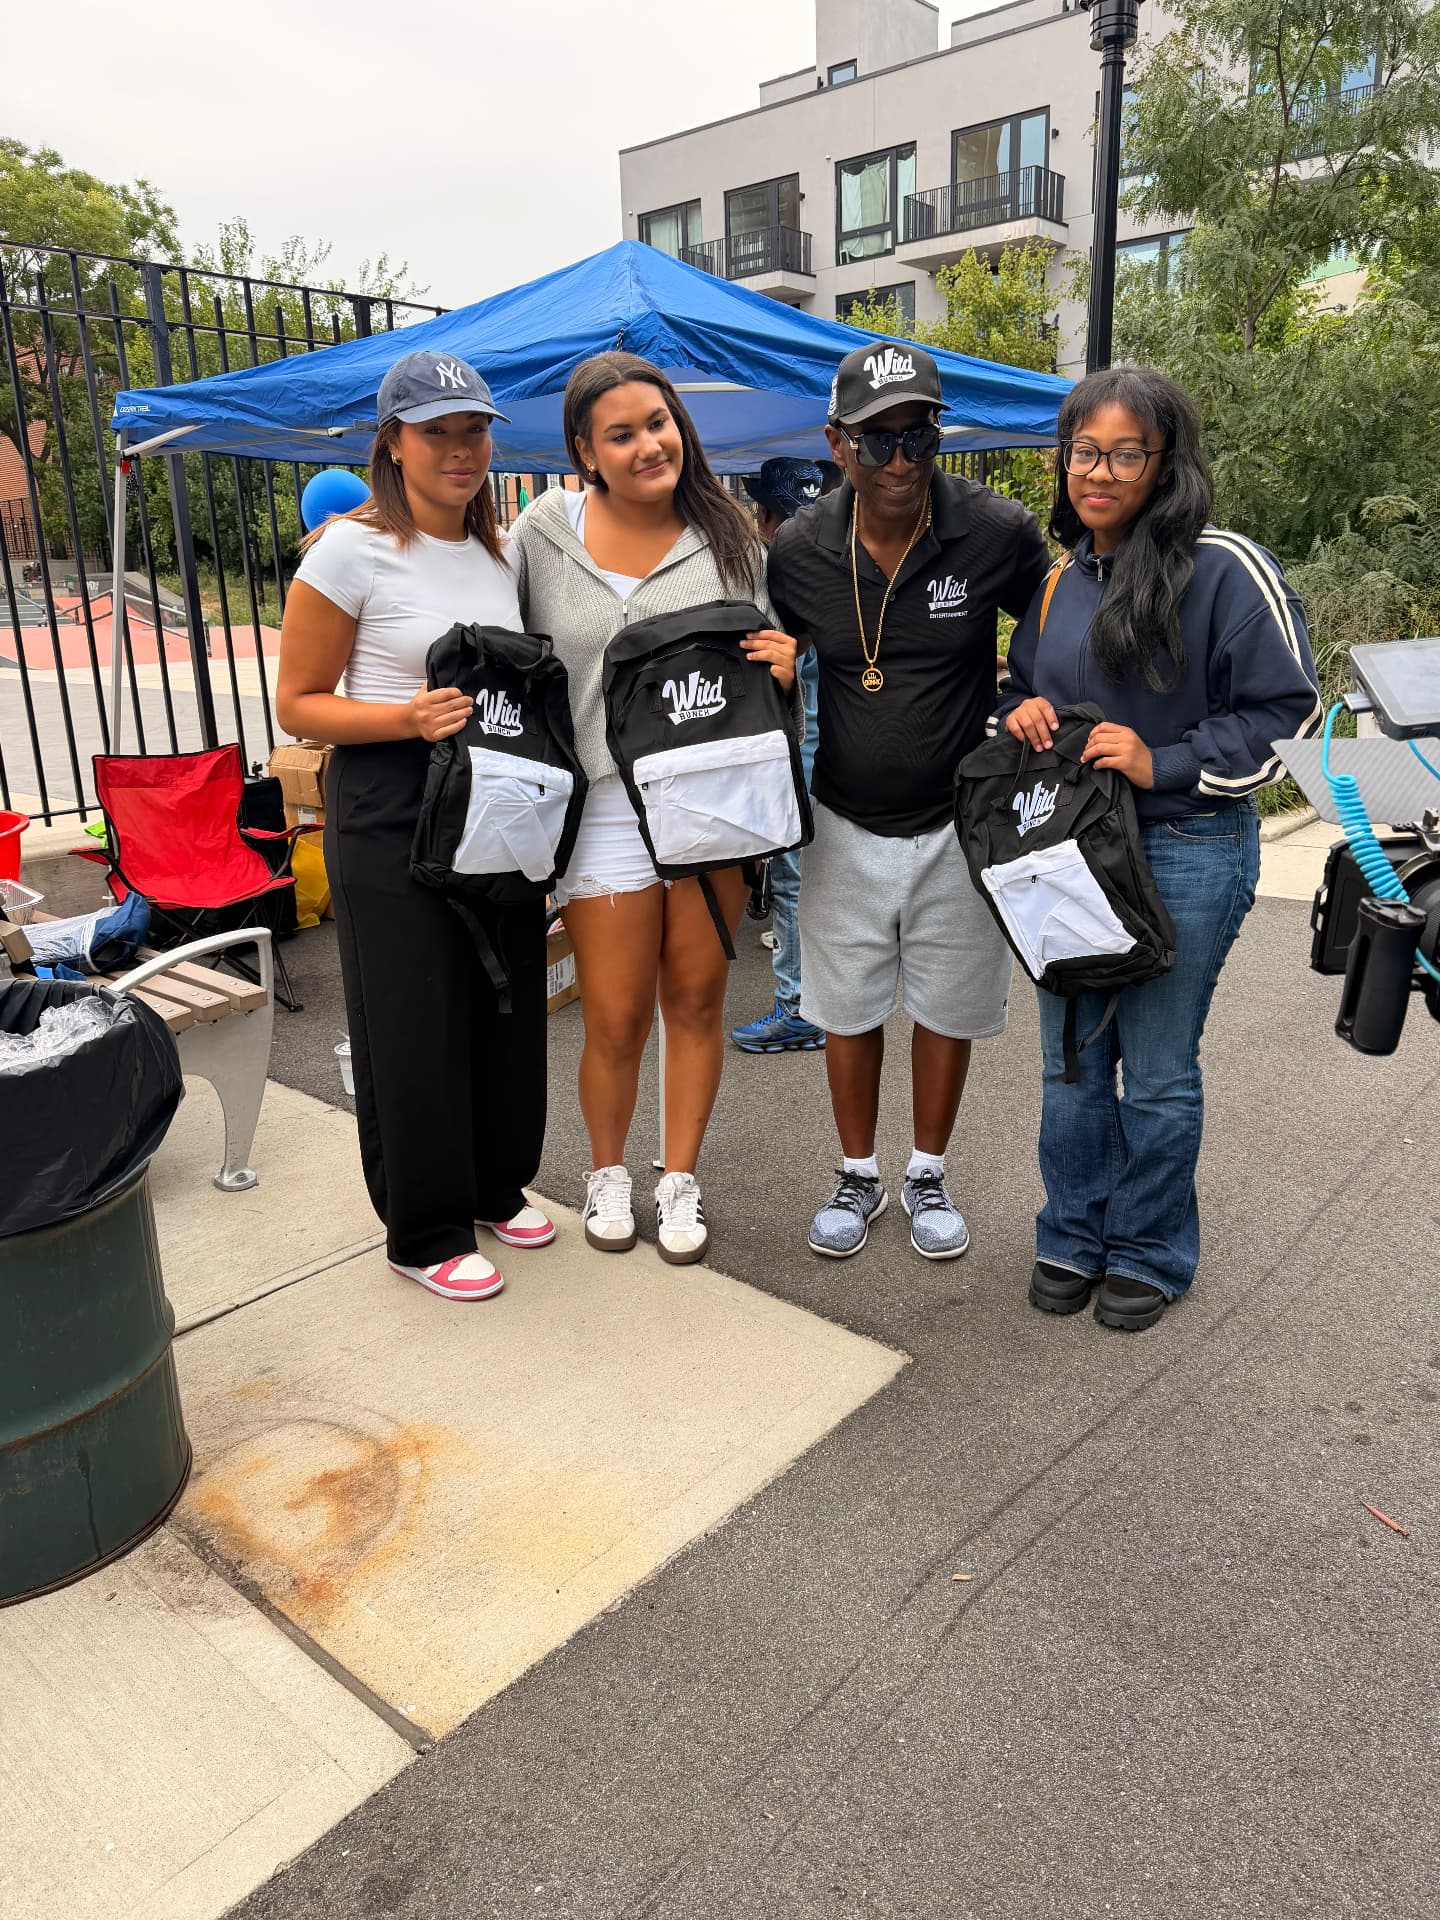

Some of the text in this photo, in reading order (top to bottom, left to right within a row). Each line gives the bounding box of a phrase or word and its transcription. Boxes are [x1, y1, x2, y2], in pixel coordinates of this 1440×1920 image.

[435, 361, 468, 389] NY
[863, 347, 912, 379] Wild
[878, 375, 904, 385] BUNCH
[926, 574, 968, 602] Wild
[661, 670, 723, 713] Wild
[475, 688, 522, 727] Wild
[679, 708, 710, 721] BUNCH
[1012, 780, 1060, 825] Wild
